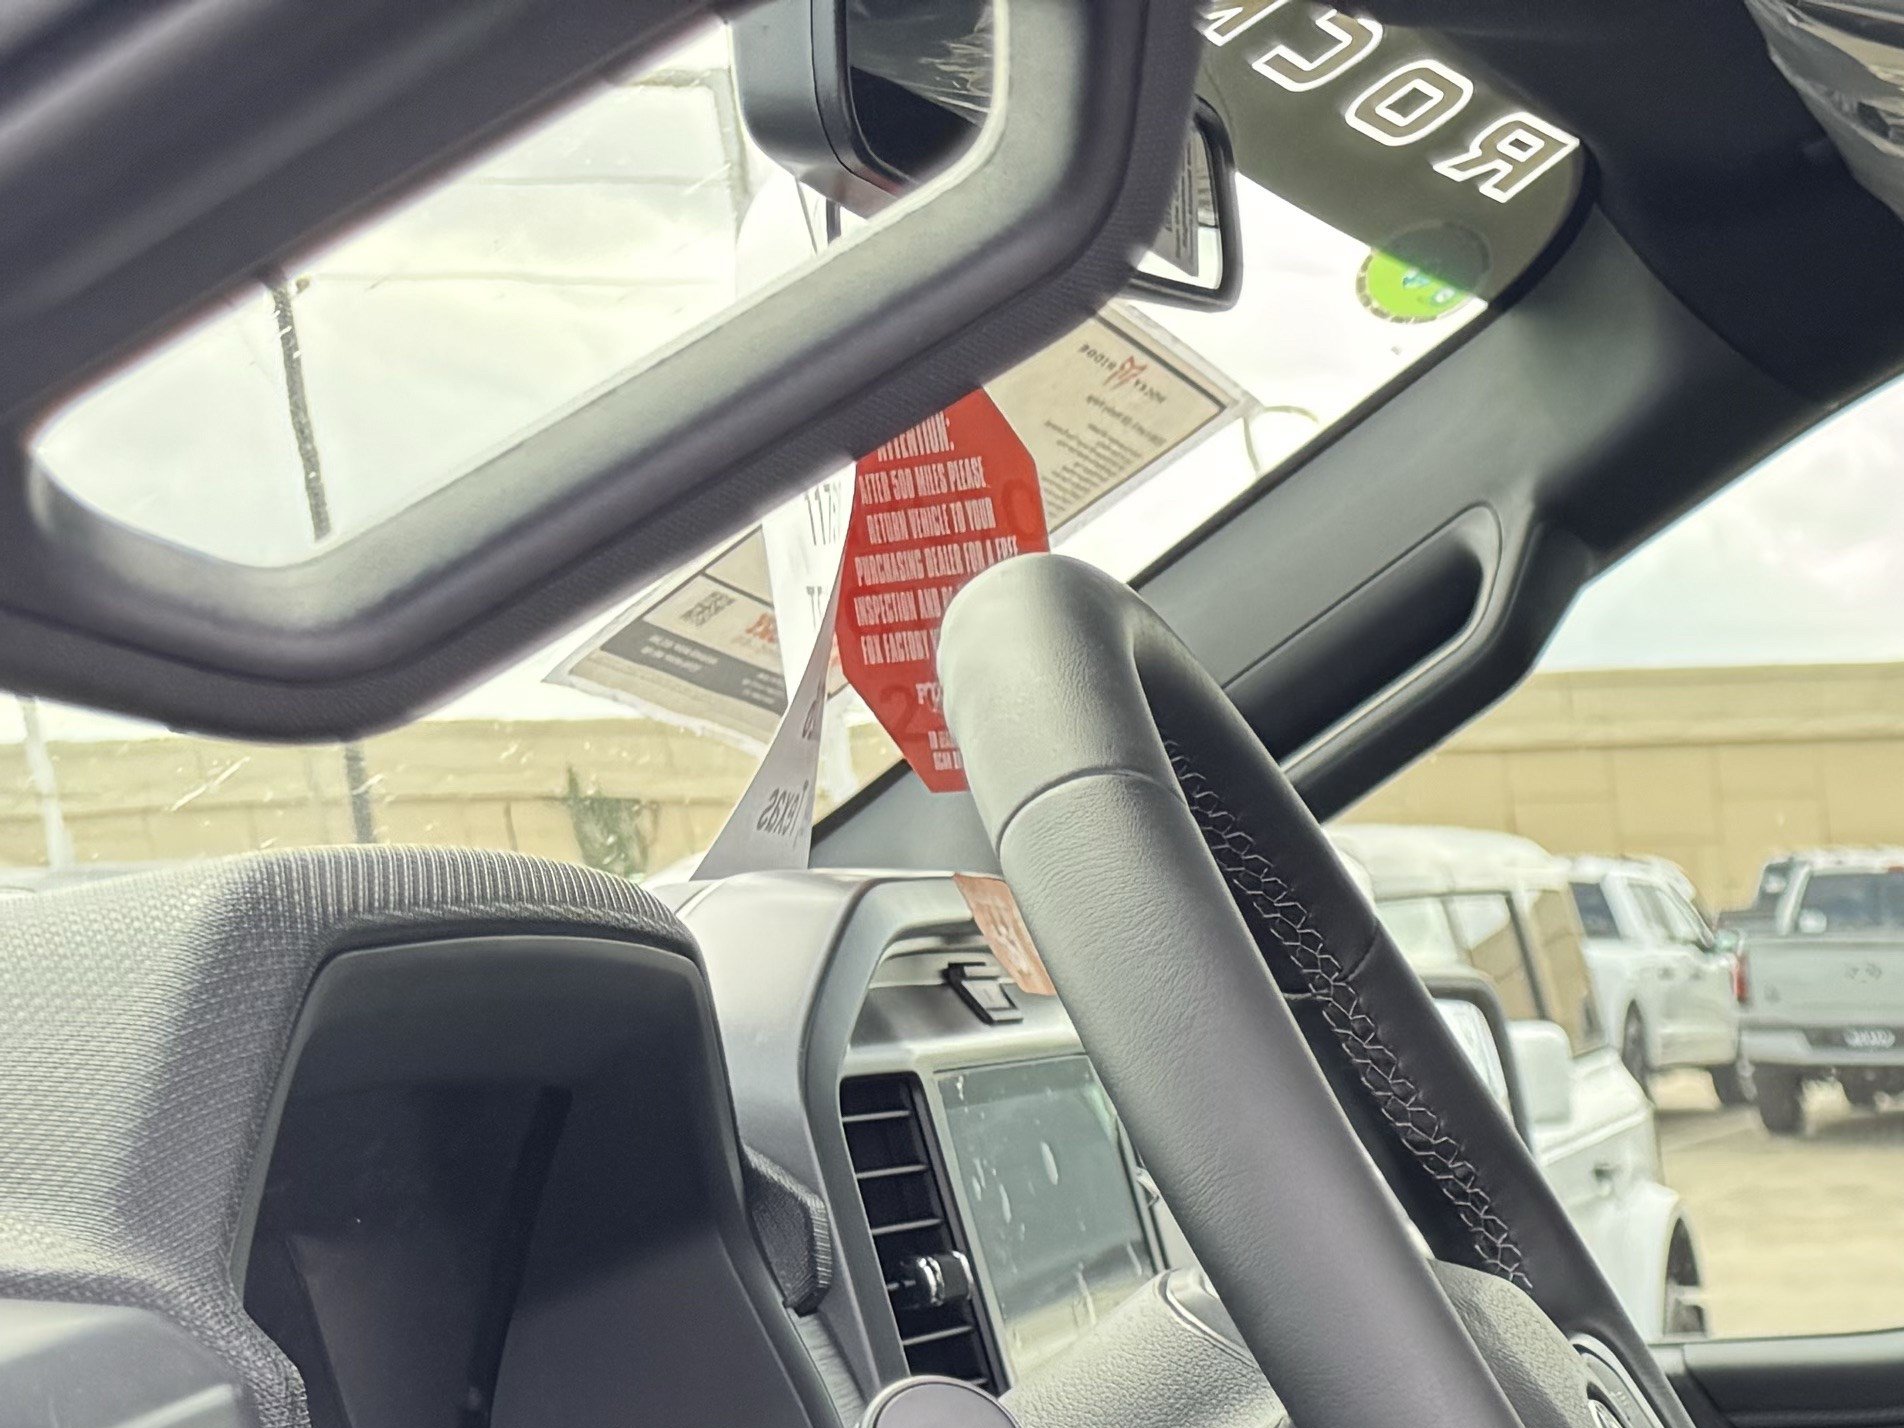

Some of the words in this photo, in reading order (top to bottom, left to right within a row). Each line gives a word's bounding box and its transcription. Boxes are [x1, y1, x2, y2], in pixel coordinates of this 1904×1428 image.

[890, 468, 915, 500] 500
[914, 462, 947, 497] MILES
[907, 503, 950, 539] VEHICLE
[950, 501, 966, 533] TO
[965, 497, 996, 531] YOUR
[855, 549, 924, 587] PURCHASING
[924, 543, 964, 578] DEALER
[854, 591, 917, 627] INSPECTION
